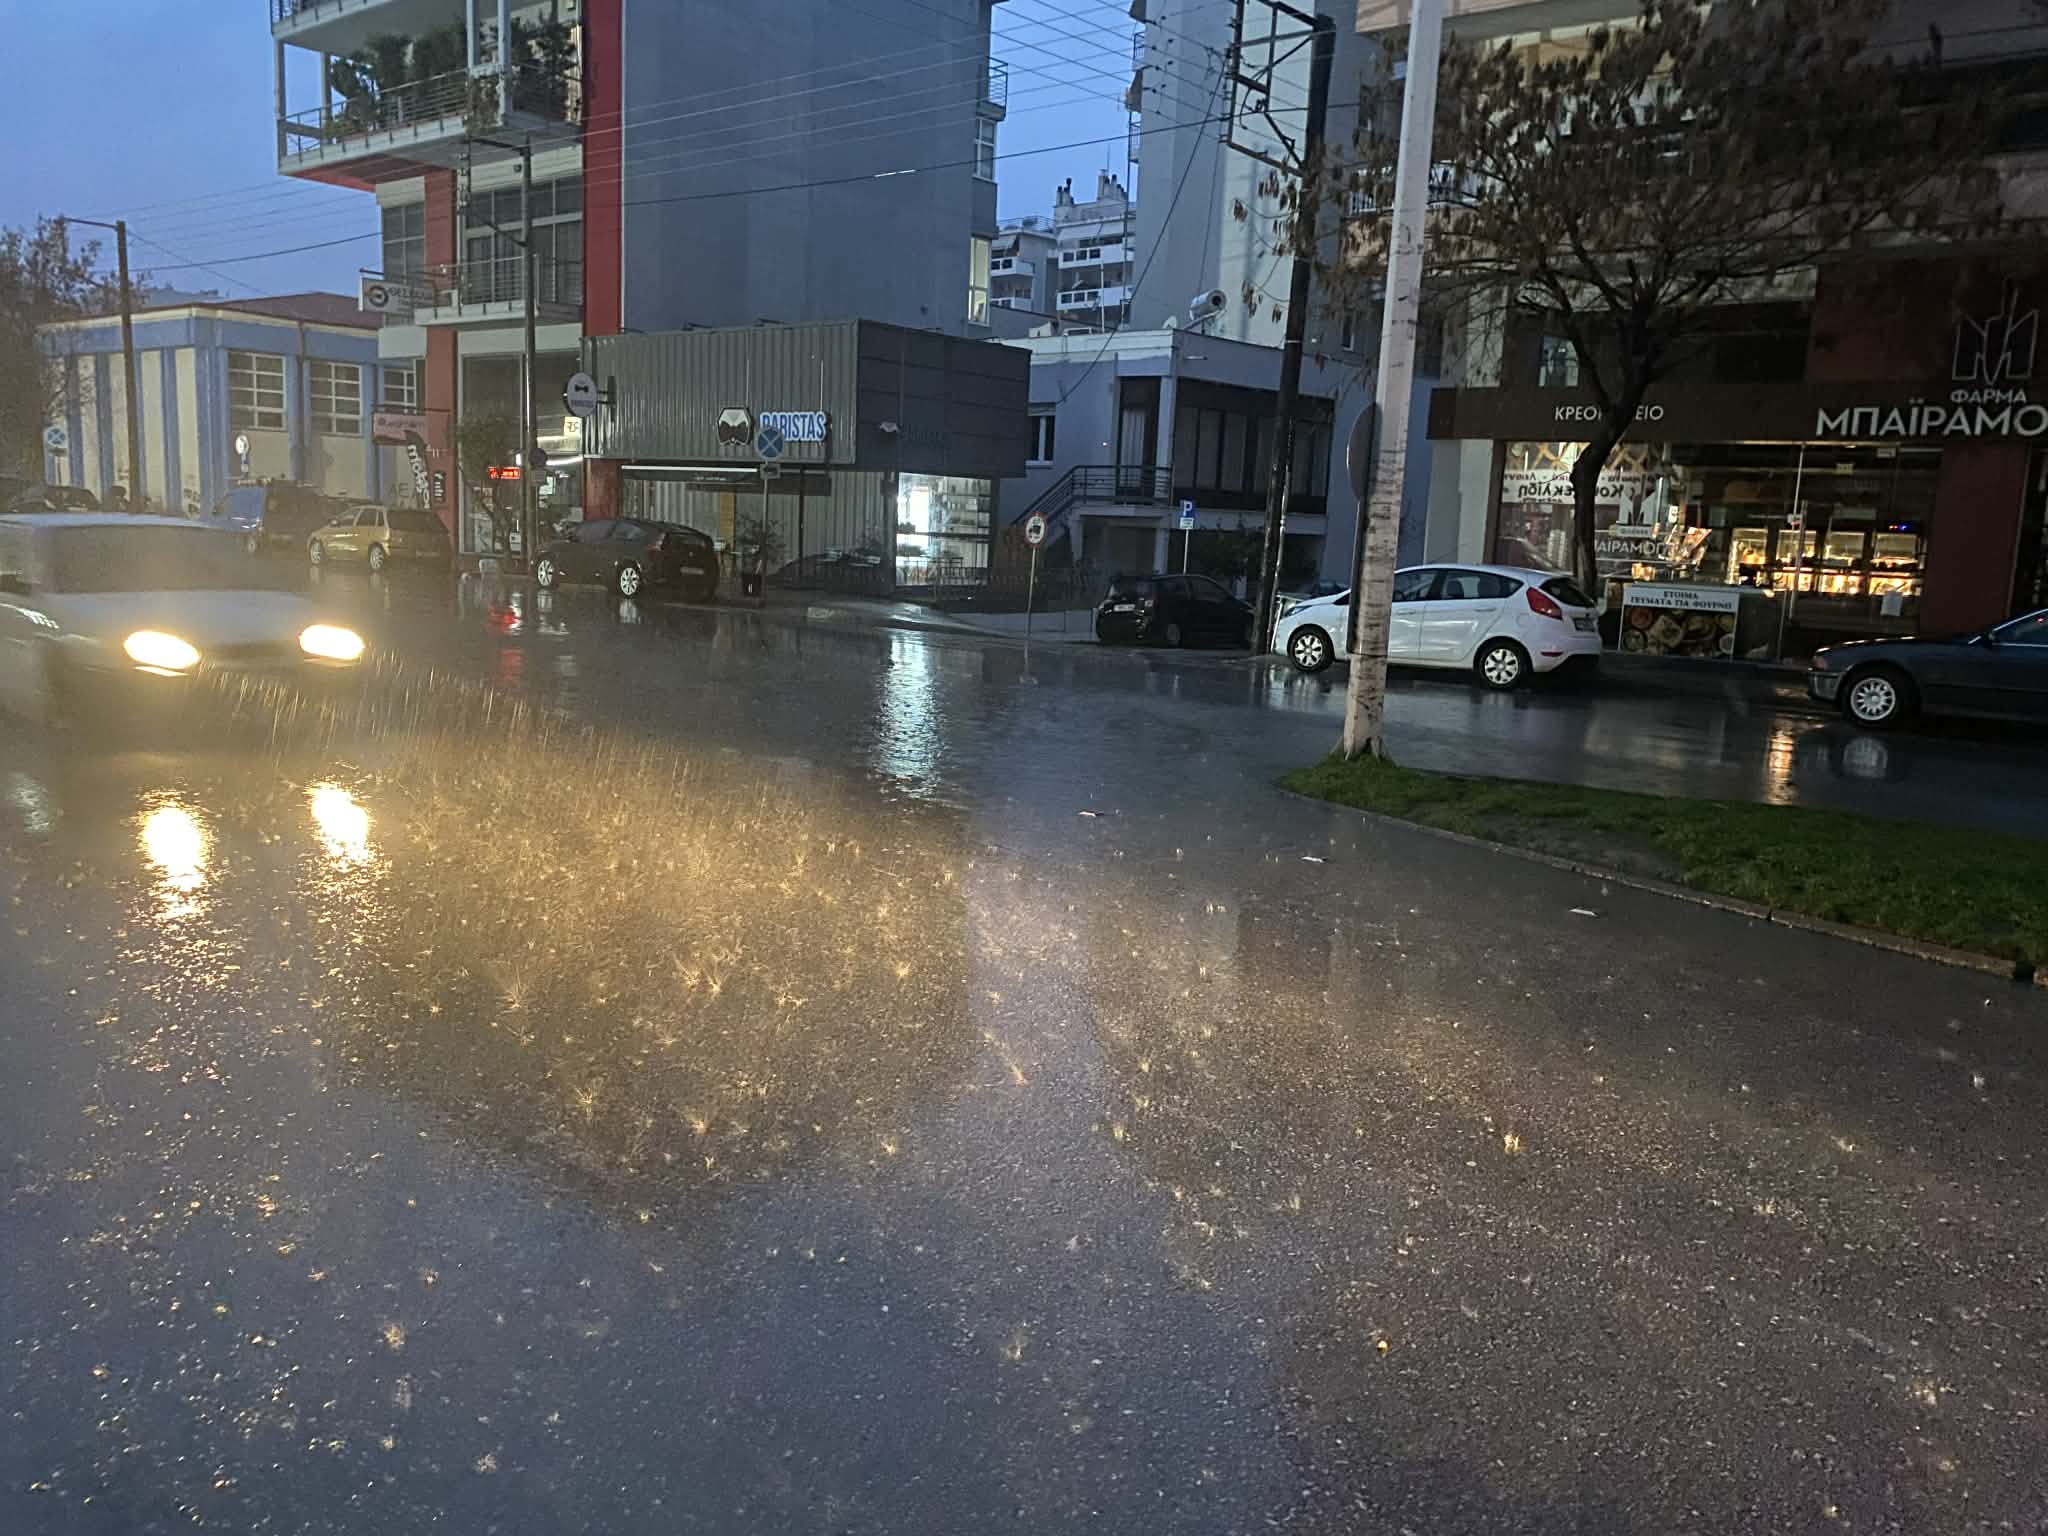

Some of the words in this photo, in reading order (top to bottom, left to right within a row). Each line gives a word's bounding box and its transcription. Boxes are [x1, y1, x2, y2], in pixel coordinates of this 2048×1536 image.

[1950, 388, 2027, 404] ΦΑΡΜΑ
[1555, 405, 1664, 421] ΚΡΕΟΕΙΟ
[1183, 500, 1193, 517] P
